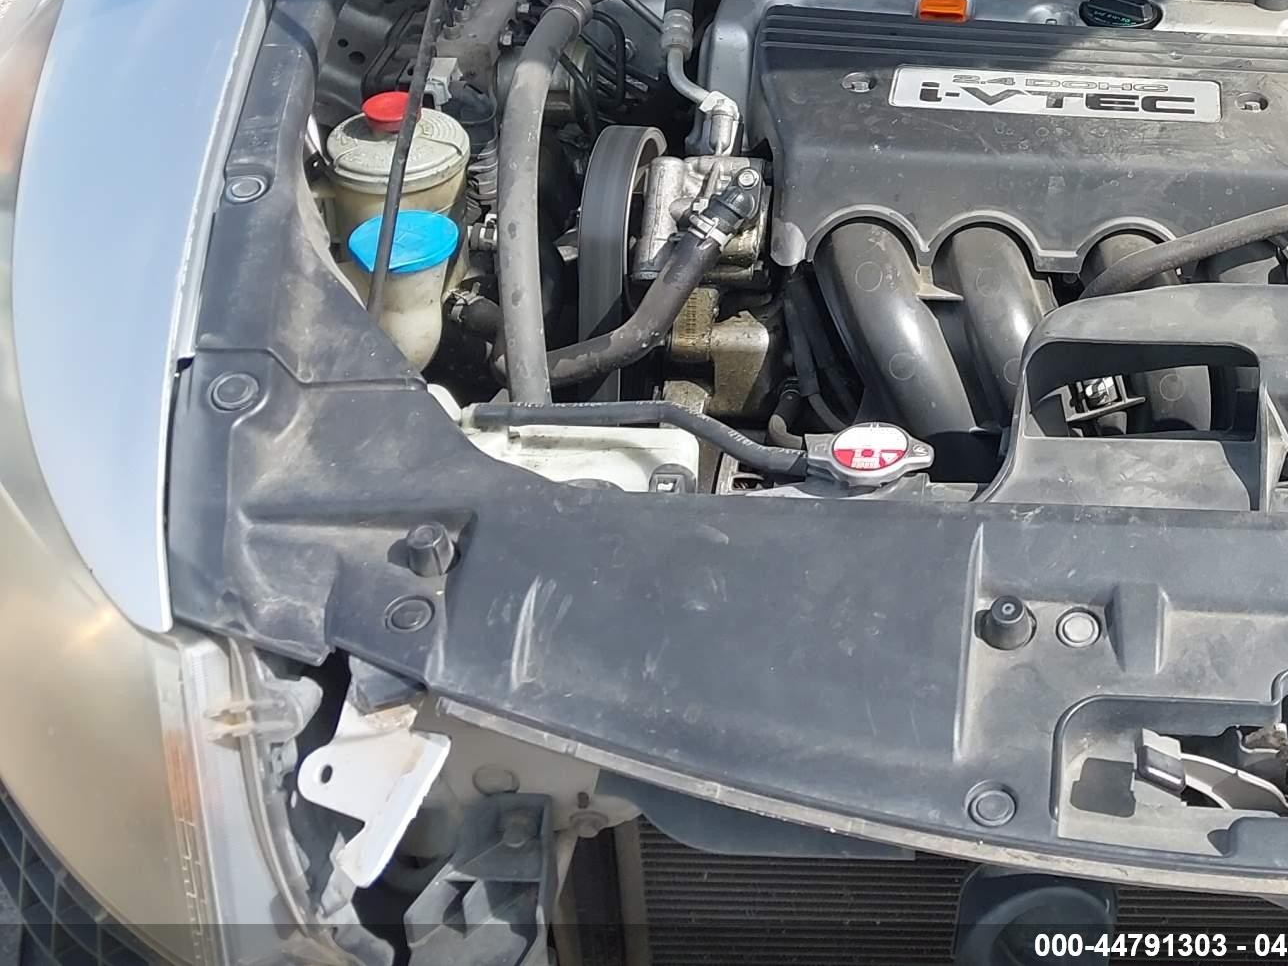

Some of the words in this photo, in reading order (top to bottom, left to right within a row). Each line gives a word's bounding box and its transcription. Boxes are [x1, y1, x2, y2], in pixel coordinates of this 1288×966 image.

[953, 74, 1015, 85] 2.4
[1025, 78, 1168, 92] DOHC
[919, 81, 1195, 115] i-VTEC
